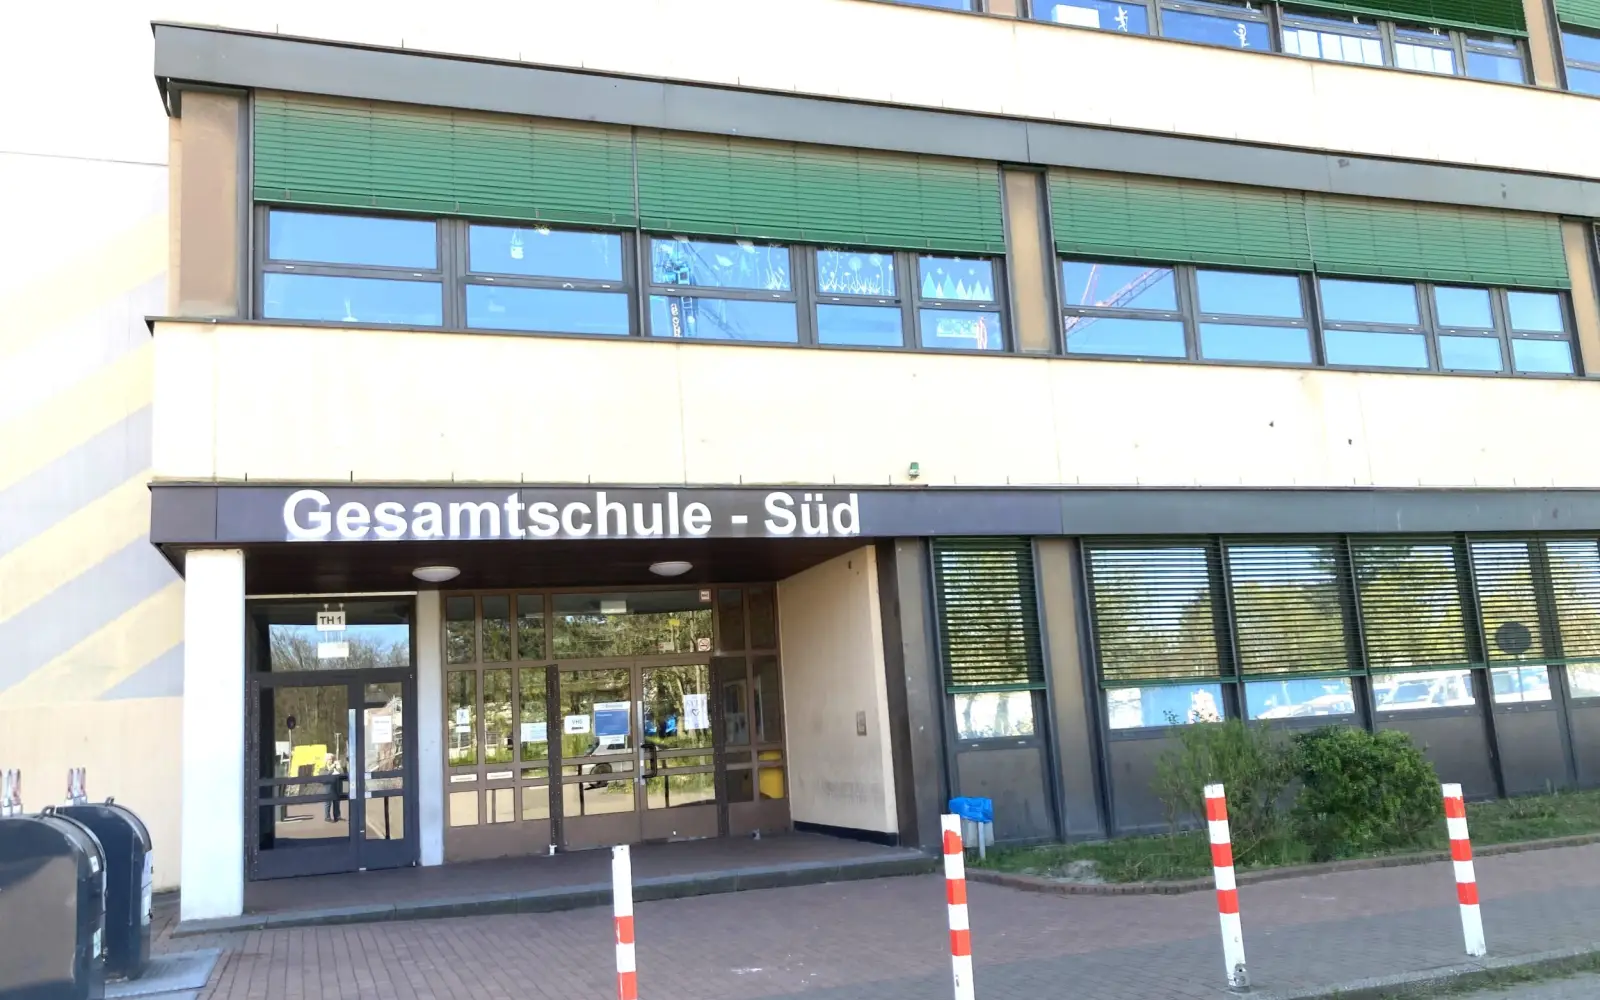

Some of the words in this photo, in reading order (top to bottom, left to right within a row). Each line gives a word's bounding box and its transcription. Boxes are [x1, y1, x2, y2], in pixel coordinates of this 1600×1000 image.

[283, 489, 712, 540] Gesamtschule
[731, 515, 748, 524] -
[764, 491, 861, 537] Süd
[320, 616, 335, 625] TH
[337, 616, 342, 625] 1
